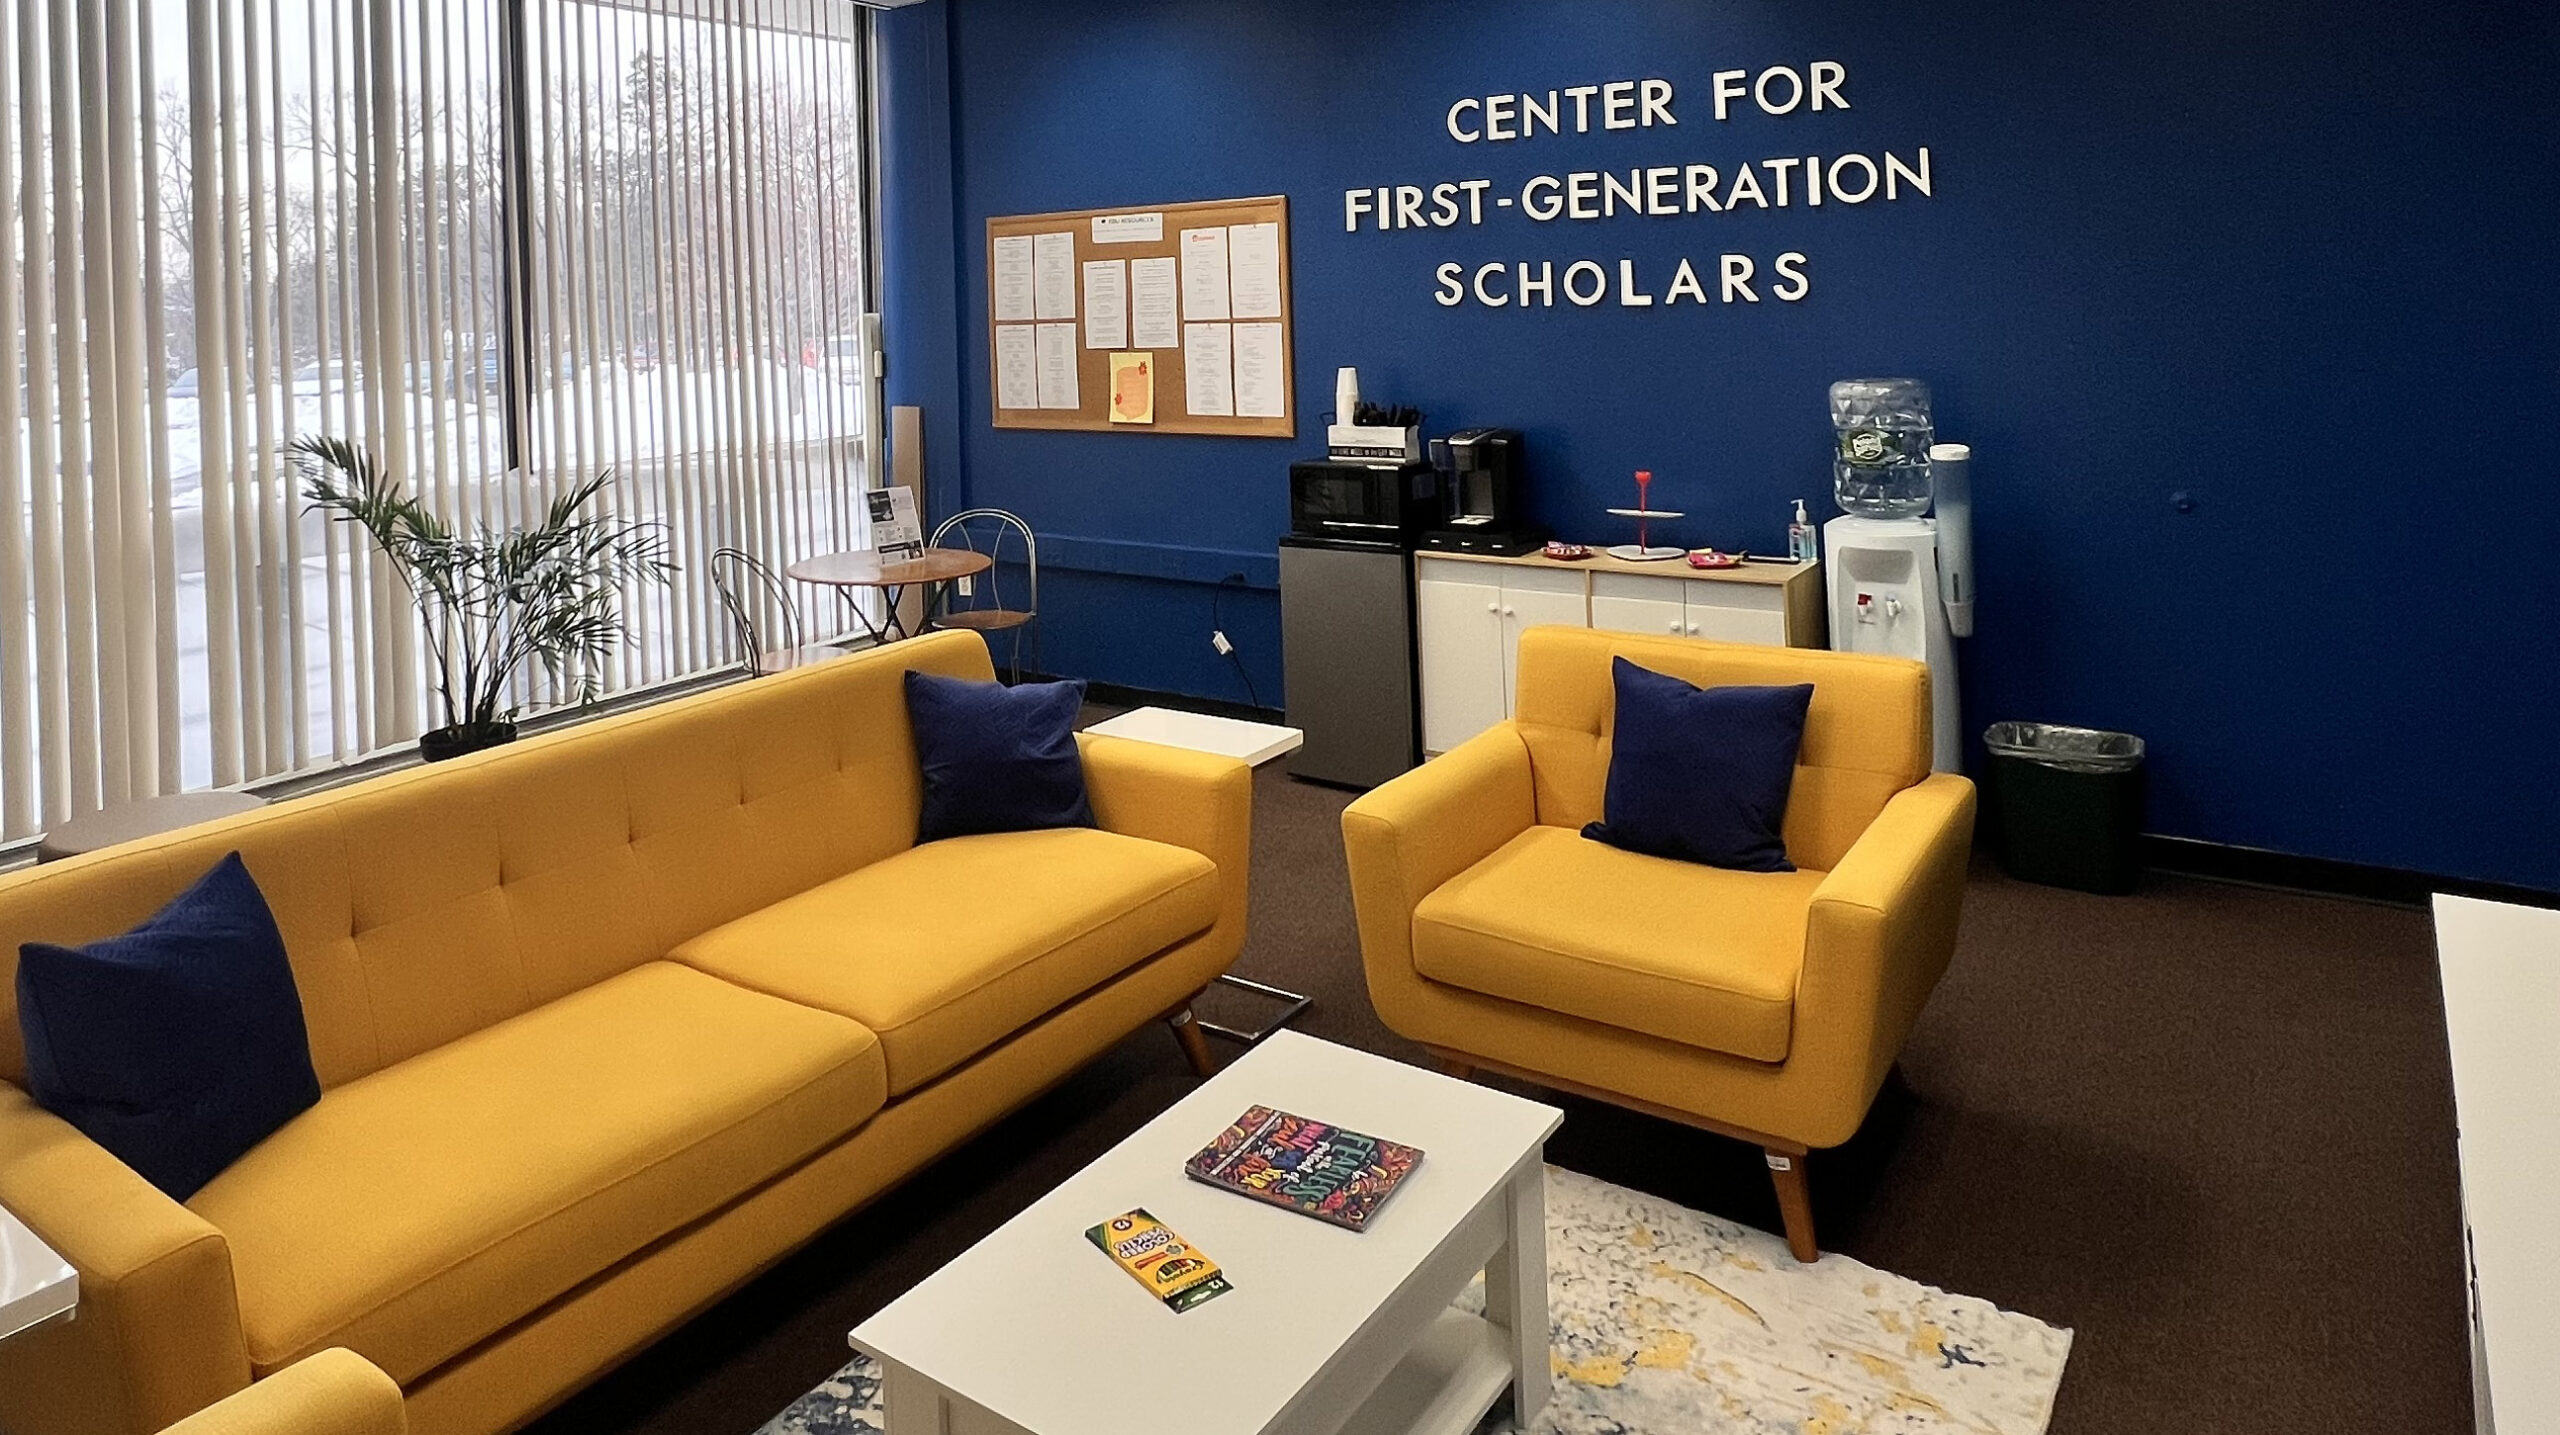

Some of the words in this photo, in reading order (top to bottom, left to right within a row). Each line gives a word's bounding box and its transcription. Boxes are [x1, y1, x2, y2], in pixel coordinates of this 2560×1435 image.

[1446, 79, 1678, 143] CENTER
[1712, 60, 1851, 120] FOR
[1345, 147, 1931, 232] FIRST-GENERATION
[1434, 251, 1809, 307] SCHOLARS
[1242, 1167, 1286, 1189] YOUR
[1282, 1131, 1376, 1200] FEARLESS
[1113, 1219, 1131, 1230] 12
[1115, 1227, 1163, 1250] PENCILS
[1120, 1231, 1174, 1258] COLORED
[1160, 1260, 1204, 1283] Crayola
[1208, 1279, 1224, 1289] 12
